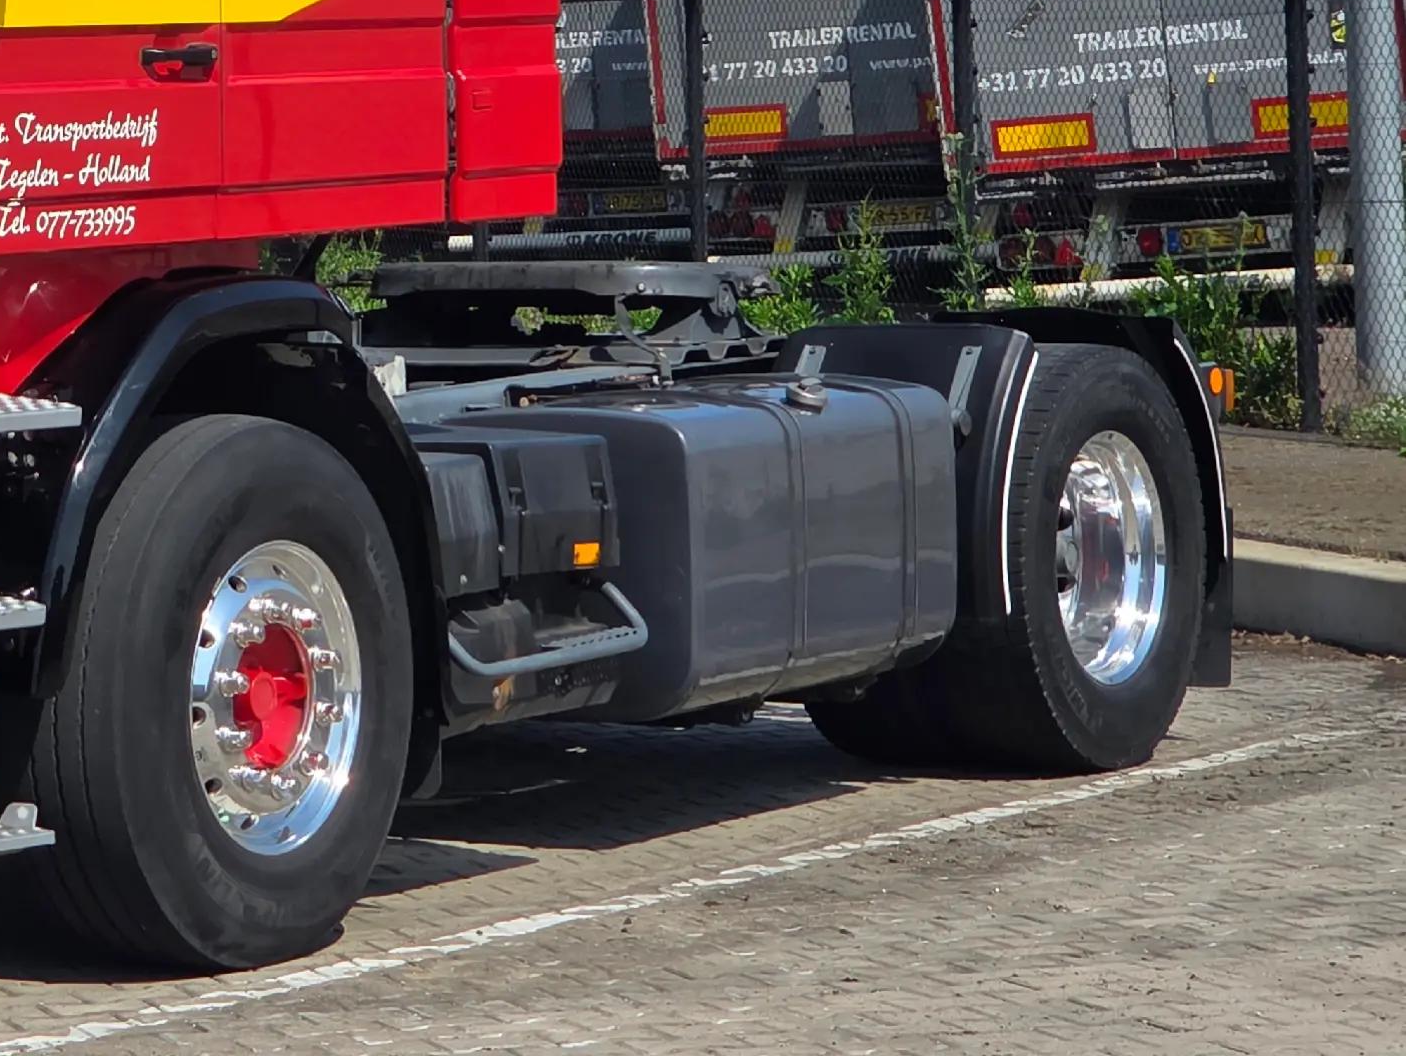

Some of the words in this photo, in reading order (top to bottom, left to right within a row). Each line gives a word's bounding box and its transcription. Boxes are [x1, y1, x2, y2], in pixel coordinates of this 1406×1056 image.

[592, 28, 646, 47] RENTA
[768, 26, 843, 50] TRAILER
[846, 21, 917, 44] RENTAL
[1073, 26, 1163, 53] TRAILER
[1165, 19, 1249, 46] RENTAL
[781, 57, 819, 77] 433
[821, 55, 848, 74] 20
[1023, 68, 1051, 89] 77
[1092, 62, 1133, 84] 433
[1139, 57, 1166, 80] 20
[14, 108, 158, 152] Transportbedrijf
[78, 152, 151, 187] Holland
[36, 205, 137, 240] 077-733995
